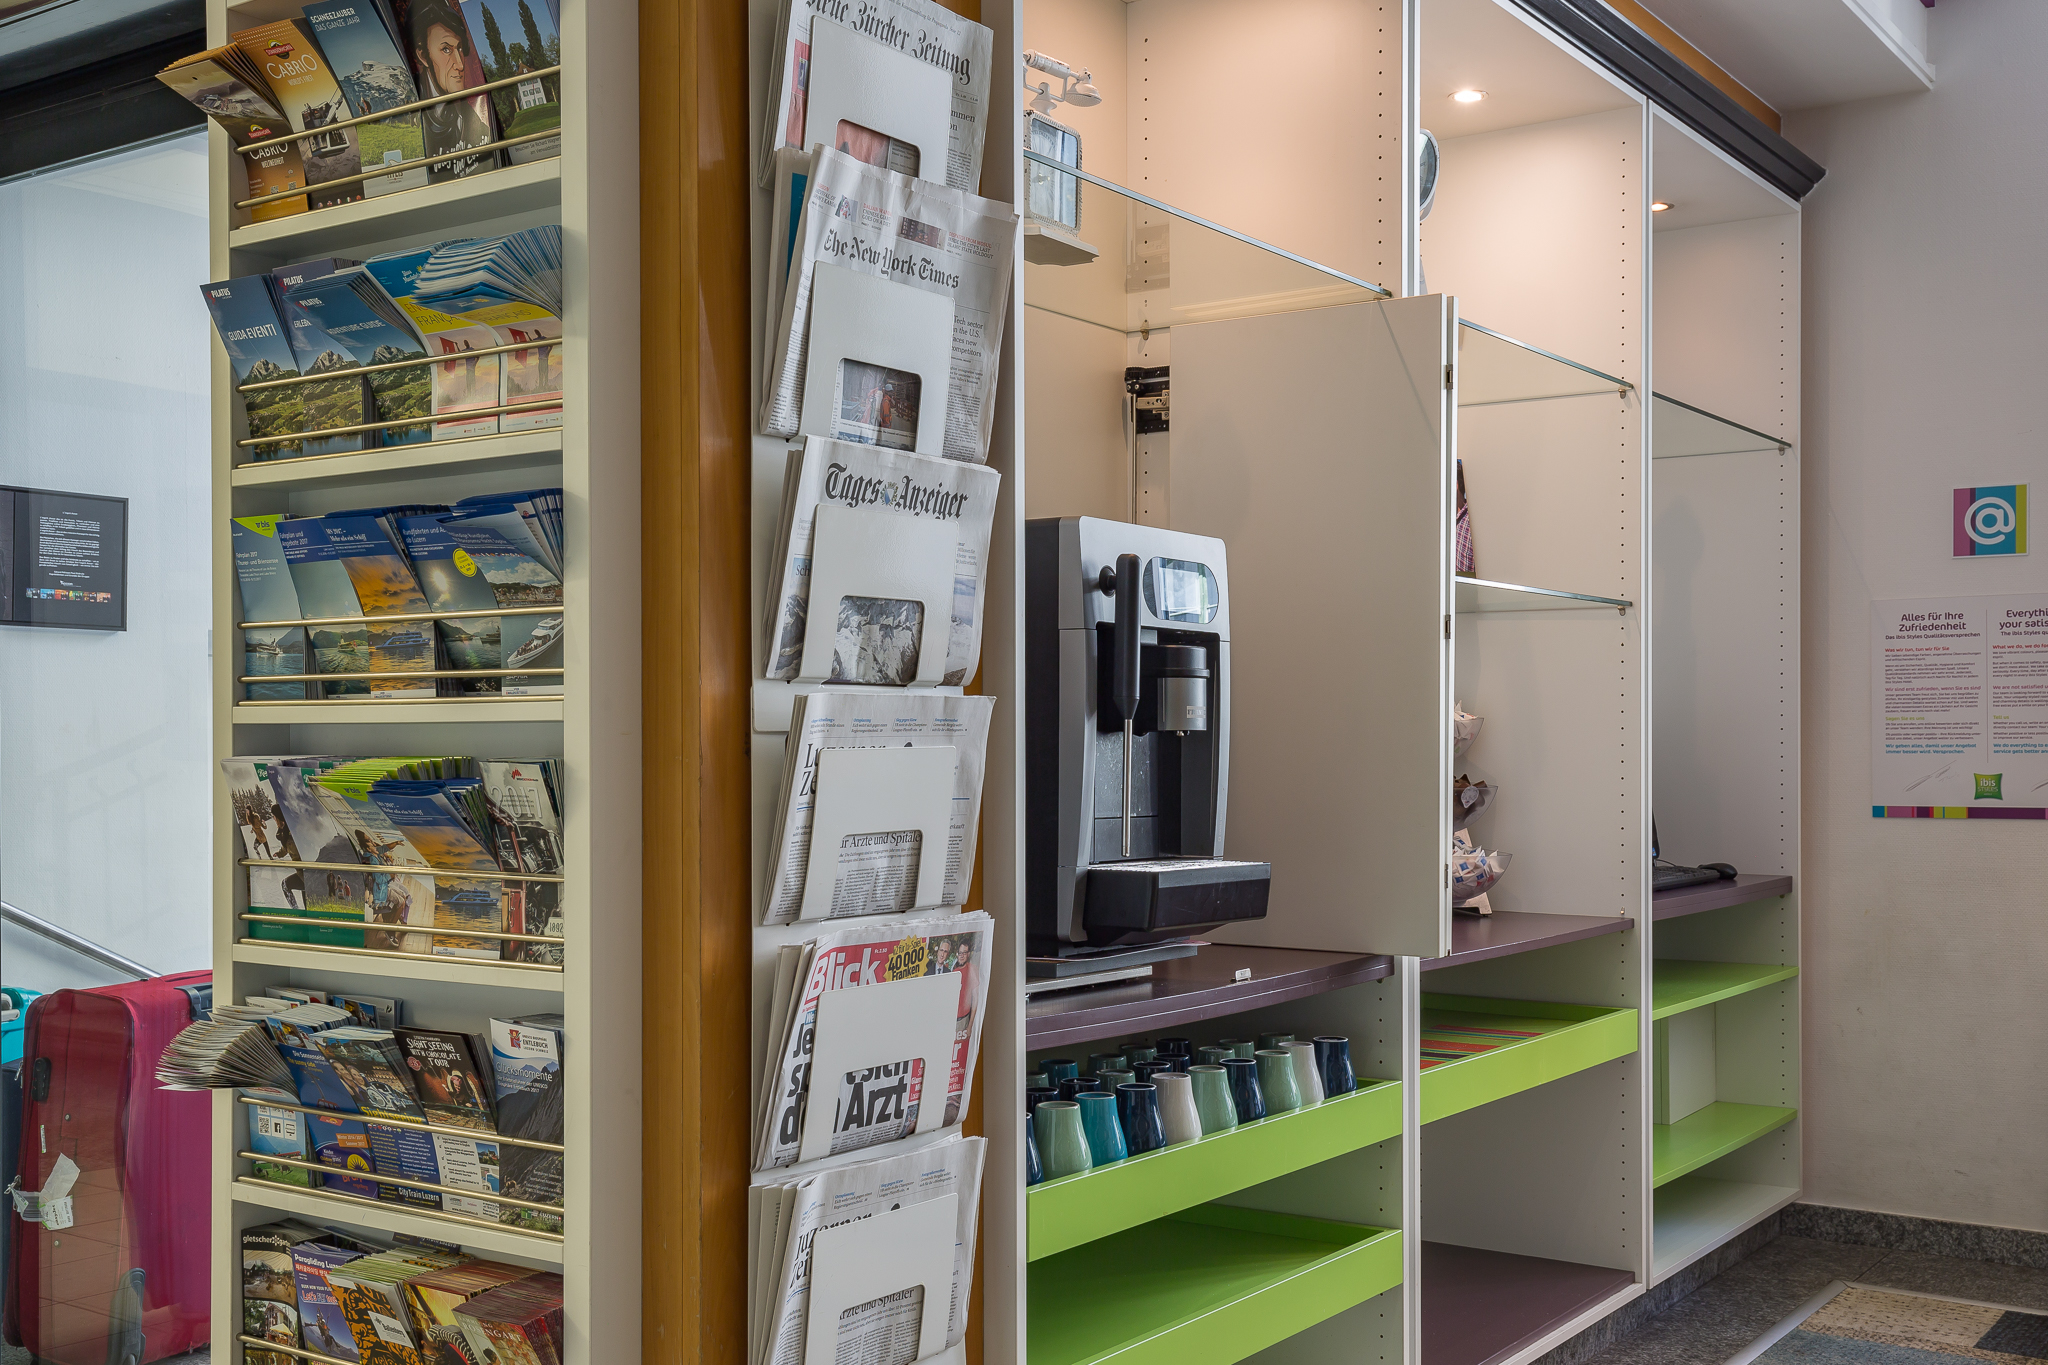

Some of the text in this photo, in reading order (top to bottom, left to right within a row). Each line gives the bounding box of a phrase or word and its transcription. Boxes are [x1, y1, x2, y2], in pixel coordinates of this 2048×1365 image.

[310, 8, 356, 23] SCHNEEZAUBER
[315, 16, 360, 32] DAS GANZE JAHR
[850, 0, 971, 86] Zürcher Zeitung
[267, 54, 318, 79] CABRIO
[288, 75, 314, 86] WORLD'S FIRST
[823, 228, 959, 289] The New York Times
[283, 275, 303, 286] PILATUS
[211, 288, 231, 298] PILATUS
[299, 298, 322, 307] PILATUS
[954, 315, 983, 331] Tech sector
[228, 324, 277, 341] GUIDA EVENTI
[959, 327, 980, 338] the U.S.
[825, 462, 968, 523] Tages Anzeiger
[1901, 612, 1964, 622] Alles für Ihre
[2006, 608, 2048, 622] Everythi
[1899, 622, 1966, 632] Zufriedenheit
[1999, 618, 2048, 630] your satis
[1980, 778, 1996, 786] ibis
[874, 832, 889, 844] und
[549, 923, 563, 932] 1892
[888, 946, 924, 972] 40 000
[806, 947, 881, 1003] Blick
[892, 965, 920, 981] Franken
[406, 1038, 455, 1053] SIGHT SEEING
[522, 1039, 549, 1050] ENTLEBUCH
[426, 1051, 462, 1061] CHOCOLATE
[496, 1062, 552, 1082] Glücksmomente
[841, 1075, 907, 1131] Arzt
[422, 1192, 440, 1201] Luzern
[243, 1235, 272, 1244] gletscher
[294, 1254, 325, 1268] Paragliding
